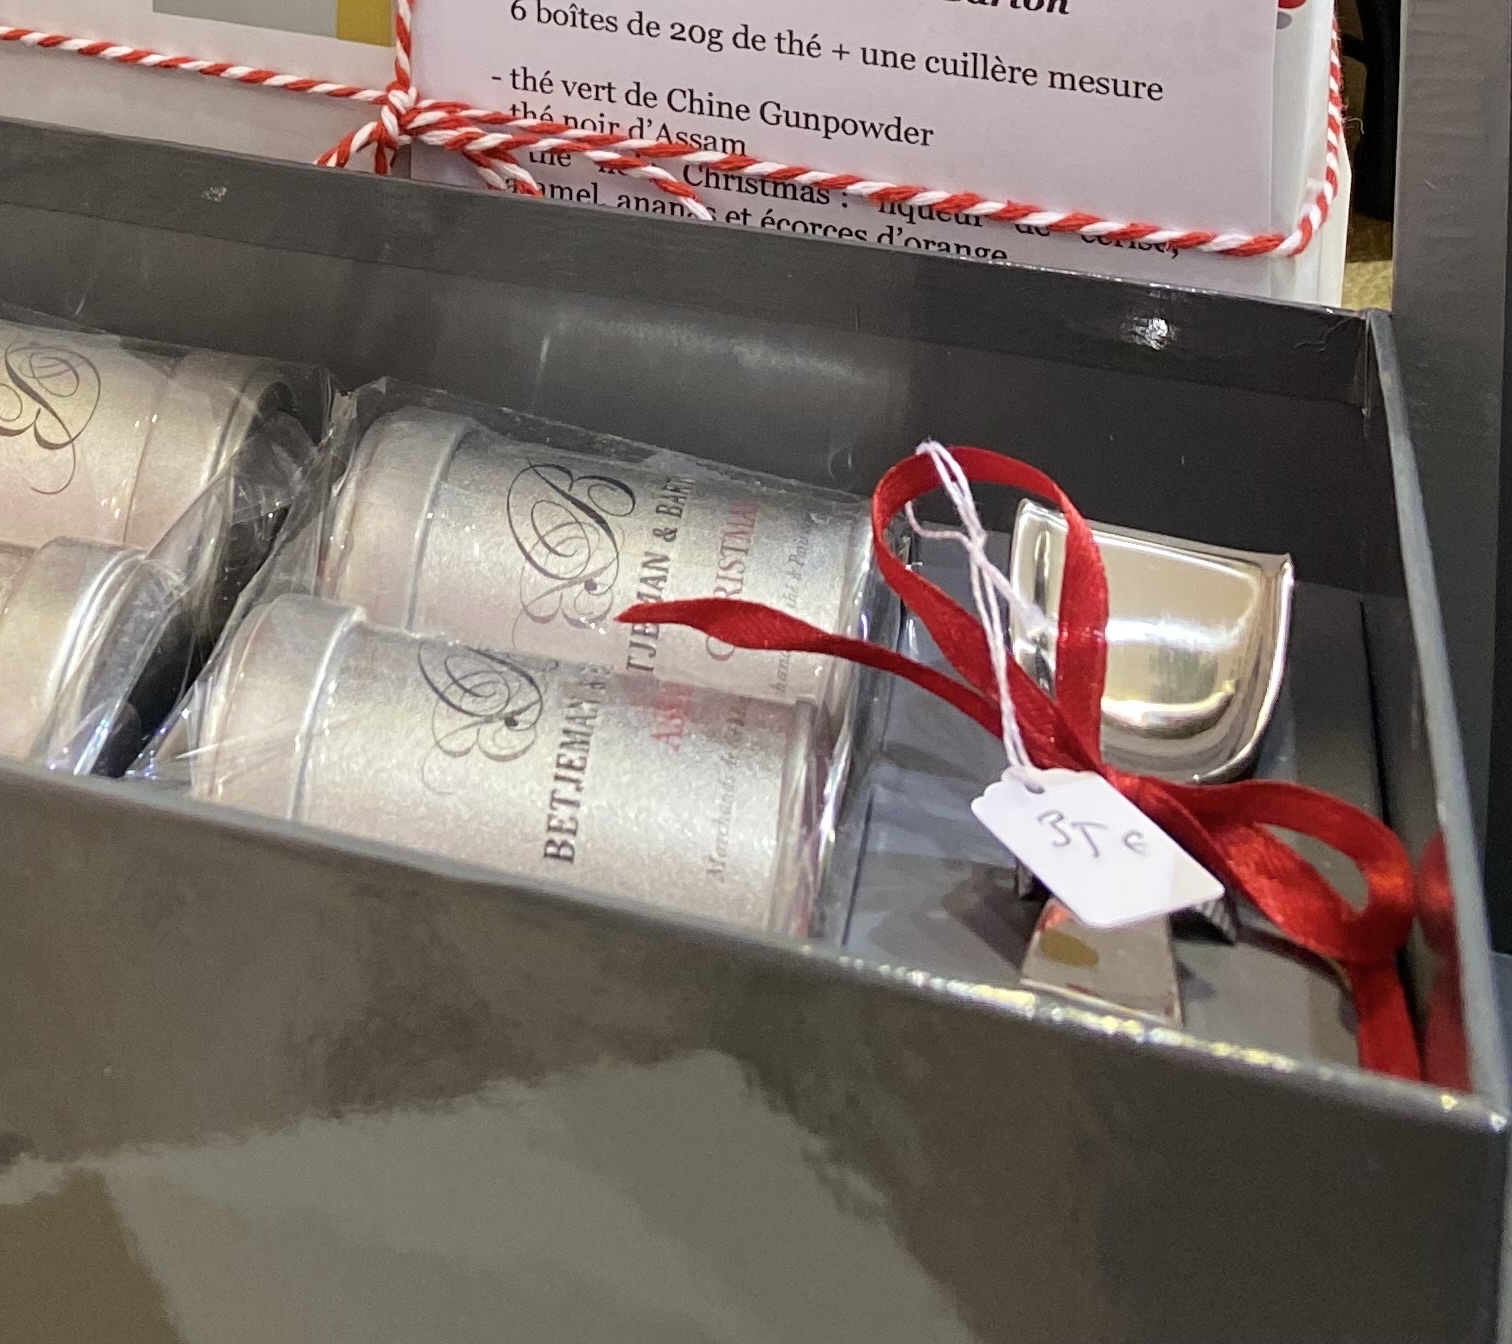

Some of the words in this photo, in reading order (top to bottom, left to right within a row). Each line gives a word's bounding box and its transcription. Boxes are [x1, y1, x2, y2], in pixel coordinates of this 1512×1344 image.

[627, 11, 661, 38] de
[670, 22, 724, 52] 20g
[732, 24, 766, 52] de
[774, 29, 822, 58] thé
[831, 44, 850, 61] +
[860, 47, 916, 71] une
[925, 52, 1038, 86] cuillère
[1048, 70, 1164, 102] mesure
[509, 66, 554, 95] thé
[561, 78, 617, 104] vert
[625, 81, 658, 108] de
[667, 88, 751, 122] Chine
[759, 100, 934, 146] Gunpowder
[682, 164, 830, 205] Christmas
[617, 193, 717, 221] anans
[725, 207, 751, 226] et
[760, 209, 867, 242] écorces
[653, 527, 678, 543] &
